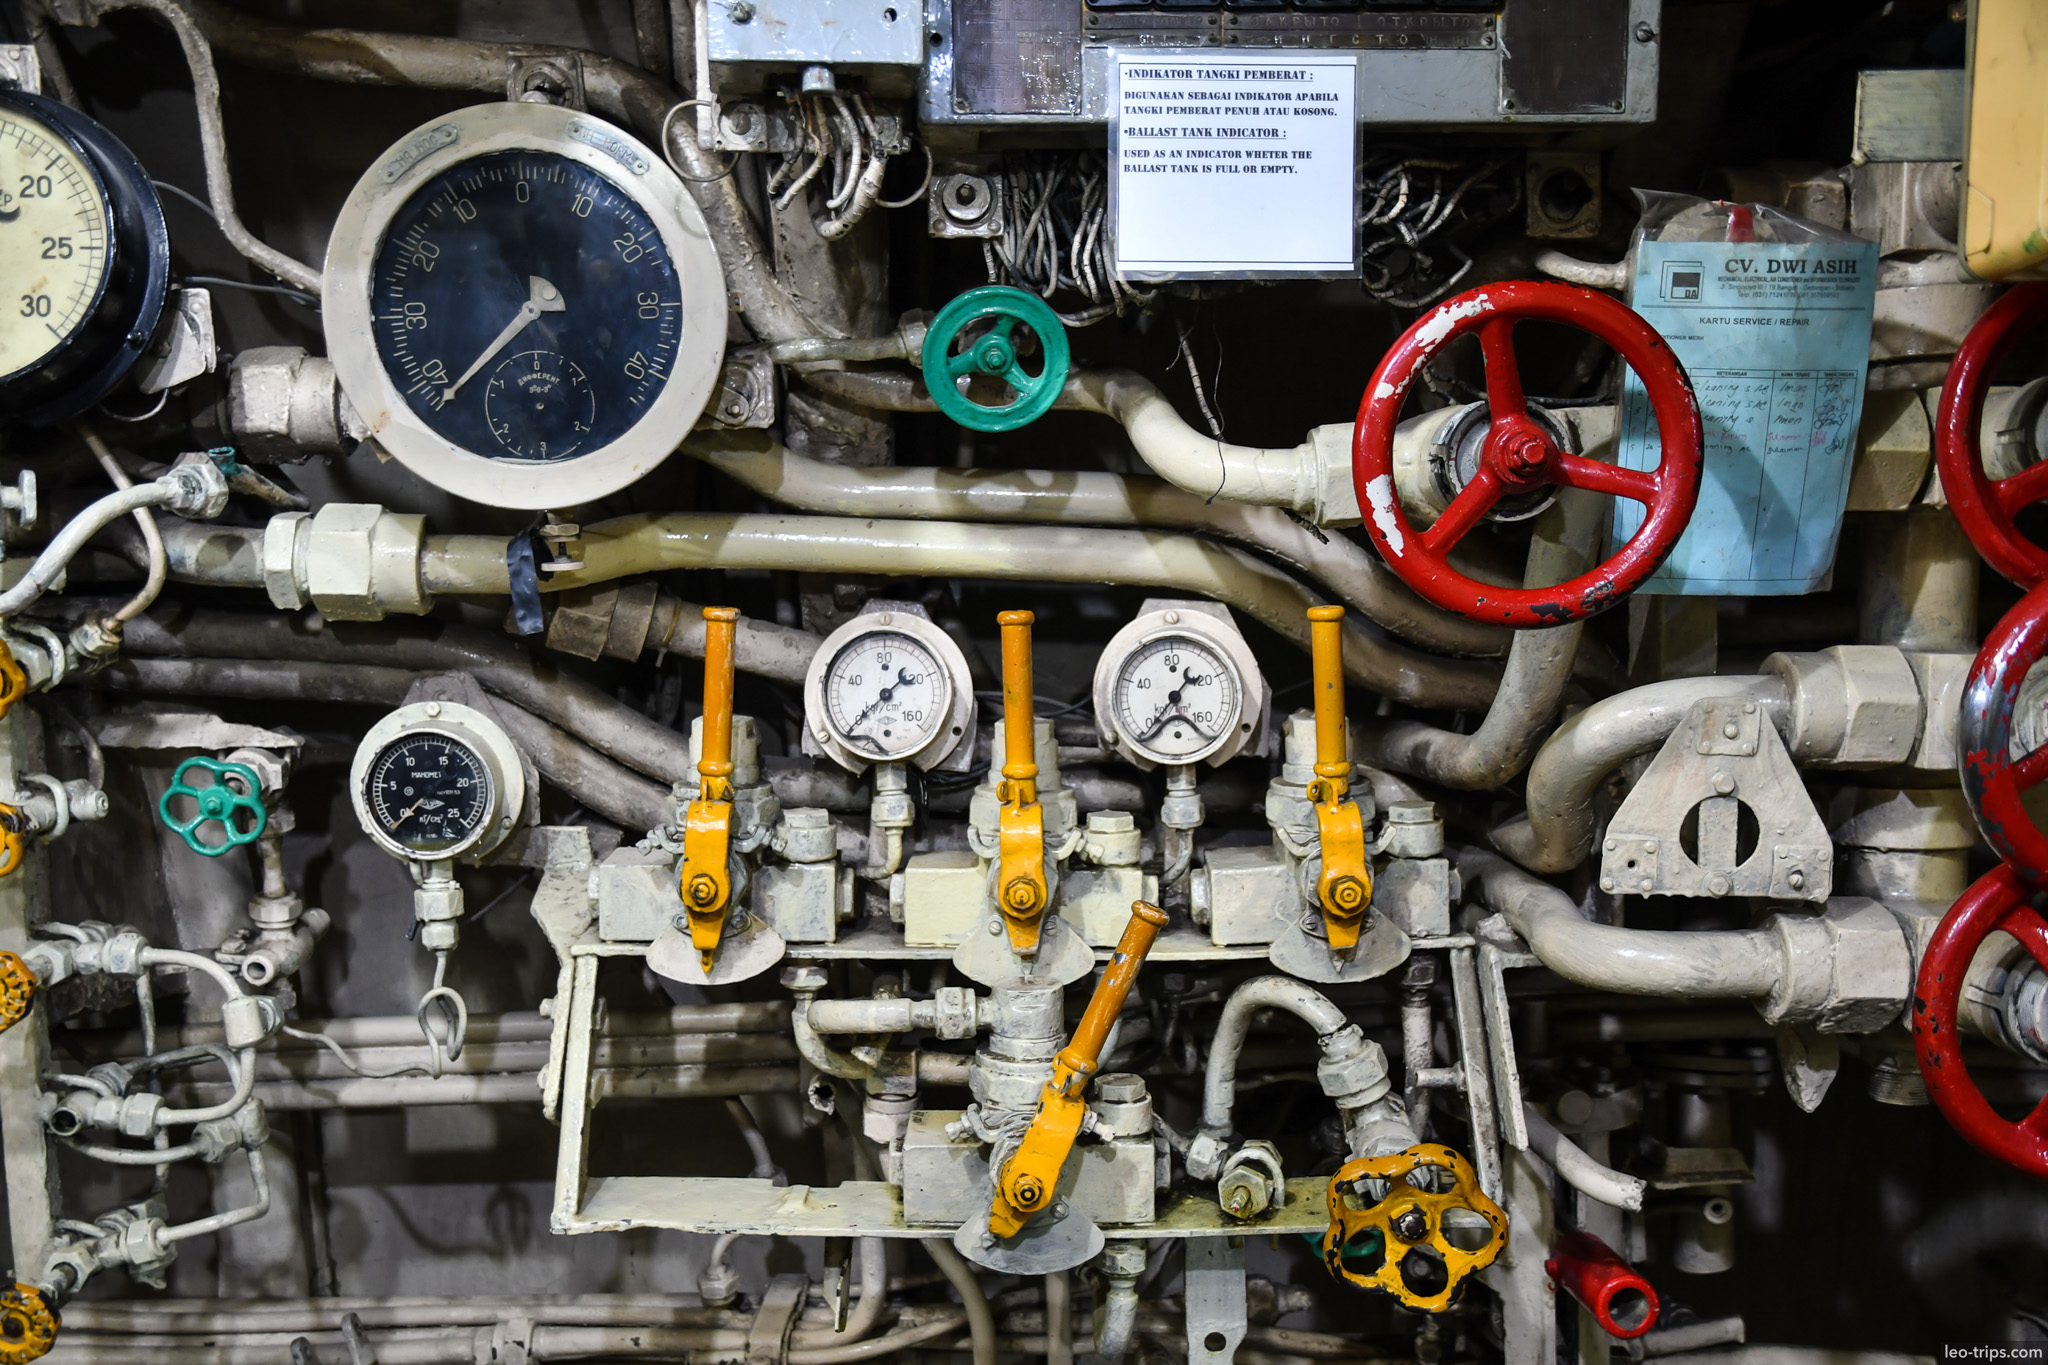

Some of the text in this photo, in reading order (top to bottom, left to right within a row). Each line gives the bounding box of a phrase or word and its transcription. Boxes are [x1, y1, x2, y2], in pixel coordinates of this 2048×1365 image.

[1128, 69, 1193, 79] INDIKATOR
[1196, 70, 1240, 80] TANGKI
[1244, 70, 1306, 80] PEMBERAT
[1124, 91, 1339, 101] DIGUNAKAN SEBAGAI INDIKATOR APABILA
[1124, 106, 1338, 116] TANGKI PEMBERAT PENUH ATAU KOSONG.
[1128, 128, 1178, 137] BALLAST
[1181, 128, 1212, 137] TANK
[1216, 128, 1279, 138] INDICATOR
[1124, 150, 1312, 159] USED AS AN INDICATOR WHETER THE
[1123, 164, 1298, 174] BALLAST TANK IS FULL OR EMPTY.
[20, 176, 52, 198] 20
[516, 181, 529, 203] 0
[453, 198, 477, 223] 10
[571, 193, 593, 218] 10
[41, 237, 72, 259] 25
[613, 232, 643, 263] 20
[413, 240, 440, 272] 20
[1725, 259, 1857, 273] CV. DWI ASIH
[20, 295, 50, 317] 30
[638, 291, 659, 320] 30
[405, 302, 427, 330] 30
[1700, 317, 1730, 325] KARTU
[1780, 318, 1809, 326] REPAIR
[534, 361, 539, 370] 0
[624, 350, 649, 380] 40
[422, 359, 449, 385] 40
[500, 380, 504, 389] 1
[572, 378, 576, 386] 1
[503, 424, 509, 433] 2
[575, 421, 580, 430] 2
[540, 442, 546, 450] 3
[877, 652, 892, 663] 80
[1164, 655, 1180, 666] 80
[848, 675, 862, 686] 40
[1137, 678, 1151, 689] 40
[855, 715, 863, 725] 0
[902, 711, 922, 722] 160
[1192, 712, 1212, 723] 160
[1145, 718, 1153, 729] 0
[405, 758, 415, 766] 10
[439, 757, 448, 766] 15
[390, 782, 397, 790] 5
[457, 778, 469, 787] 20
[447, 809, 460, 817] 25
